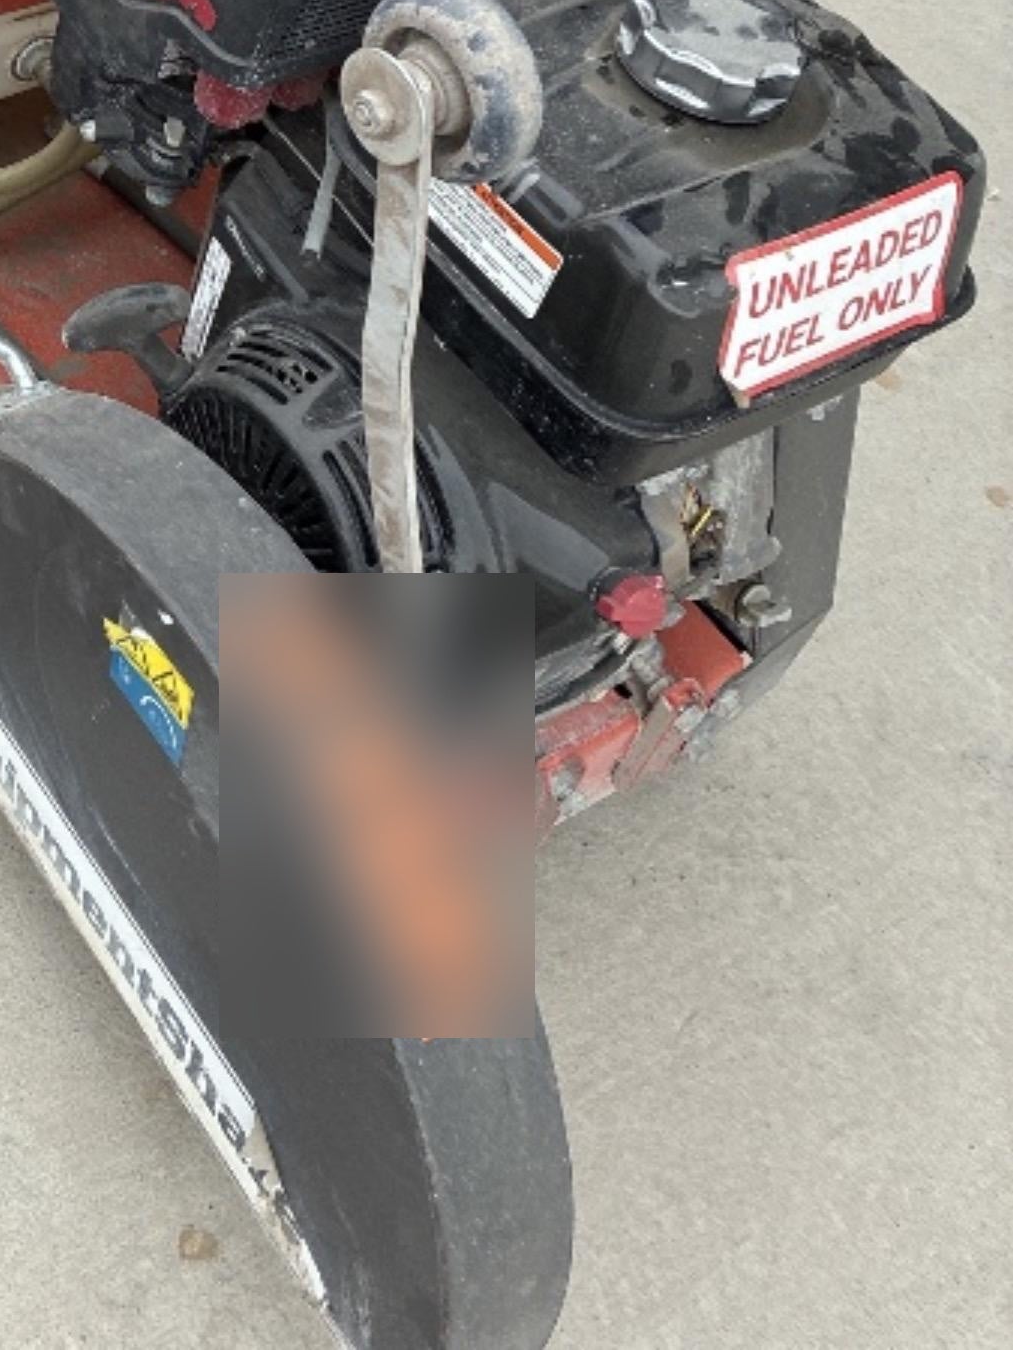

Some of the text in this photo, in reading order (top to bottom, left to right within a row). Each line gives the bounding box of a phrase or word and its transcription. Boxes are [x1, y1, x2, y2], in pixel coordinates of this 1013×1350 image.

[749, 210, 942, 318] UNLEADED
[734, 264, 933, 378] FUEL ONLY
